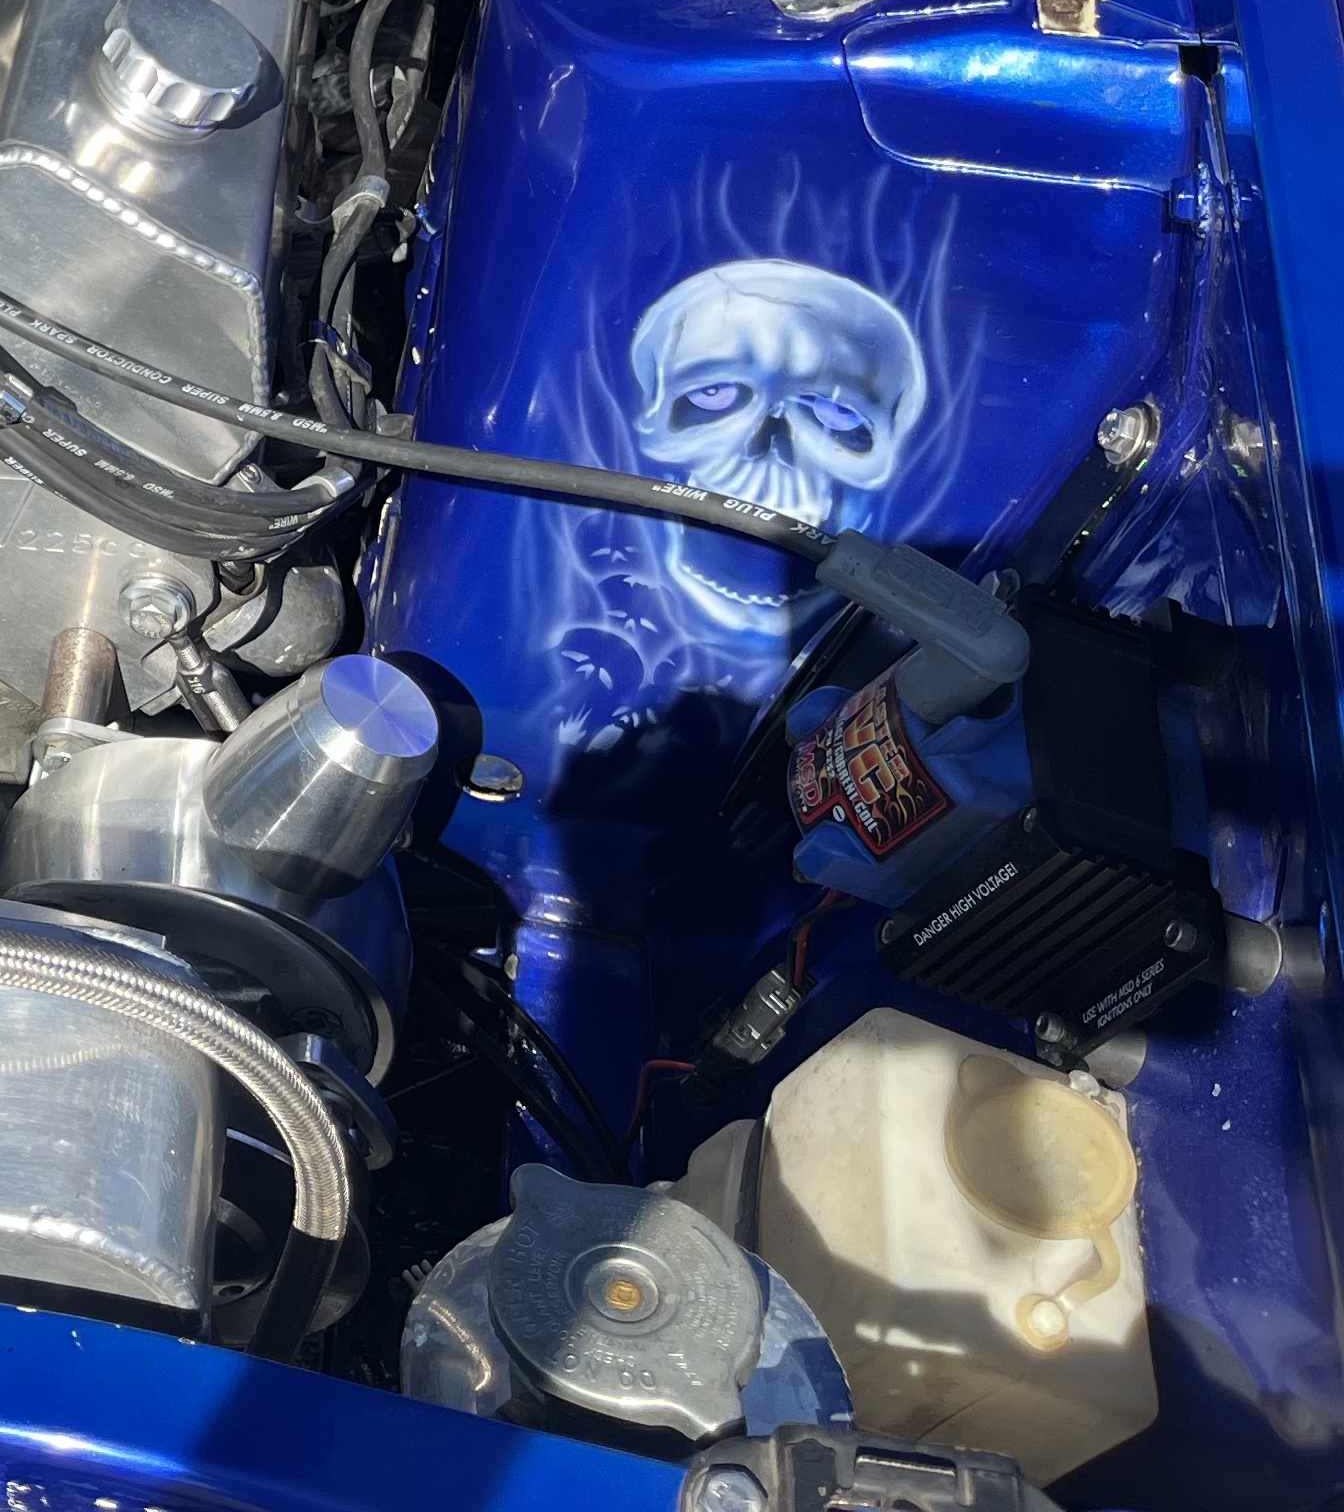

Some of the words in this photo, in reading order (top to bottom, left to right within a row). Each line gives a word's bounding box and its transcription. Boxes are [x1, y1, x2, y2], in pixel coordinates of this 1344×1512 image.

[29, 319, 78, 344] SPARK
[86, 345, 172, 384] CONDUCTOR
[181, 383, 230, 405] SUPER
[42, 428, 87, 457] SUPER
[723, 499, 777, 521] PLUG
[789, 522, 836, 545] ARK
[854, 801, 878, 833] COIL
[913, 912, 953, 947] DANGER
[948, 893, 977, 920] HIGH
[1082, 1005, 1097, 1024] USE
[1097, 990, 1118, 1014] WITH
[1118, 979, 1135, 1000] MSD
[1135, 974, 1141, 988] 6
[1141, 957, 1165, 984] SERIES
[1097, 995, 1133, 1029] IGNITIONS
[1133, 982, 1153, 1004] ONLY
